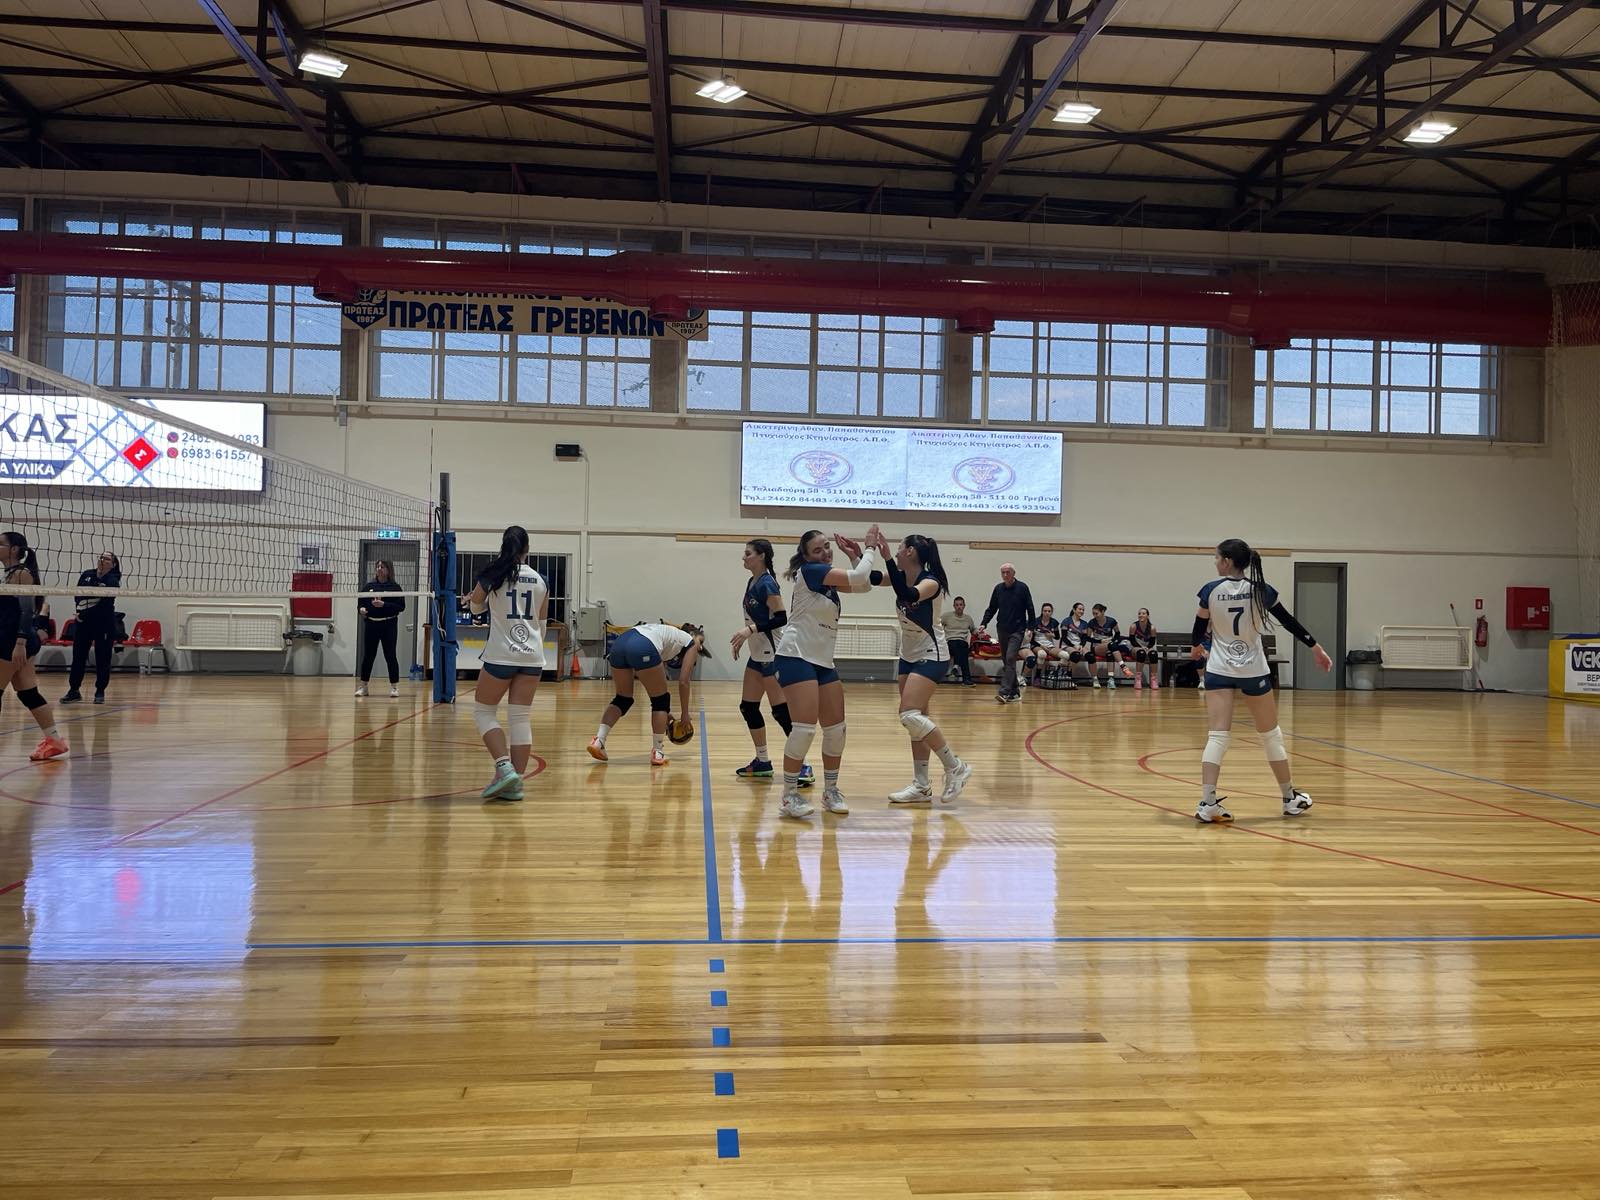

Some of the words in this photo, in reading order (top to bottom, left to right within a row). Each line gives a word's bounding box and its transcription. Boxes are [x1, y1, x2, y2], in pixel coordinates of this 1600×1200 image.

[344, 305, 385, 315] ΠΡΩΤΕΑΣ
[389, 301, 514, 332] ΠΡΩΤΕΑΣ
[12, 462, 56, 475] ΥΛΙΚΑ
[506, 589, 533, 620] 11
[1228, 607, 1244, 636] 7
